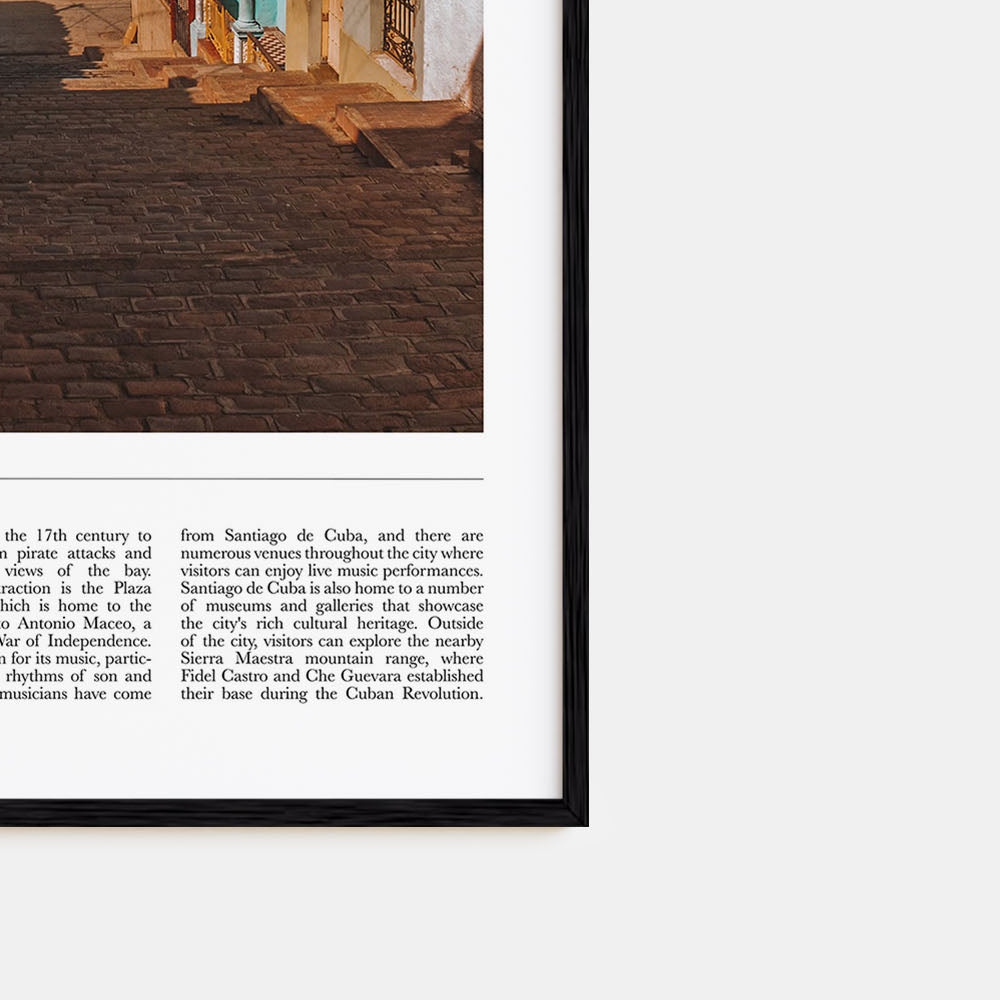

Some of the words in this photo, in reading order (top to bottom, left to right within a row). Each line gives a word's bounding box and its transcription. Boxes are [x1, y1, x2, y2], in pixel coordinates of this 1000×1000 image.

[180, 528, 215, 542] from
[224, 528, 288, 546] Santiago
[296, 528, 314, 542] de
[323, 528, 368, 544] Cuba,
[377, 529, 405, 542] and
[415, 529, 452, 542] there
[461, 533, 484, 542] are
[16, 547, 59, 563] pirate
[67, 546, 116, 559] attacks
[124, 546, 152, 559] and
[180, 550, 252, 559] numerous
[253, 550, 302, 559] venues
[304, 546, 384, 563] throughout
[386, 546, 410, 559] the
[412, 547, 439, 563] city
[440, 546, 484, 559] where
[4, 564, 44, 577] views
[56, 563, 74, 577] of
[87, 564, 111, 577] the
[124, 564, 152, 580] bay.
[180, 564, 231, 577] visitors
[234, 568, 260, 577] can
[264, 564, 304, 581] enjoy
[308, 564, 333, 577] live
[337, 564, 379, 577] music
[382, 563, 484, 581] performances.
[60, 582, 72, 594] is
[81, 581, 104, 594] the
[113, 581, 152, 594] Plaza
[39, 599, 50, 612] is
[58, 599, 99, 612] home
[106, 602, 121, 612] to
[129, 599, 152, 612] the
[180, 598, 198, 612] of
[205, 603, 272, 612] museums
[279, 599, 308, 612] and
[315, 599, 374, 615] galleries
[382, 599, 411, 612] that
[418, 599, 484, 612] showcase
[17, 617, 76, 629] Antonio
[83, 616, 136, 632] Maceo,
[143, 621, 152, 629] a
[180, 616, 204, 629] the
[212, 617, 248, 633] city's
[256, 616, 284, 629] rich
[292, 616, 348, 629] cultural
[357, 616, 418, 633] heritage.
[427, 616, 484, 629] Outside
[180, 651, 224, 664] Sierra
[235, 651, 294, 664] Maestra
[304, 652, 374, 664] mountain
[385, 656, 430, 668] range,
[440, 651, 484, 664] where
[5, 669, 64, 686] rhythms
[70, 669, 87, 682] of
[93, 673, 118, 682] son
[124, 669, 152, 682] and
[180, 669, 216, 682] Fidel
[221, 669, 269, 682] Castro
[273, 669, 301, 682] and
[305, 669, 336, 682] Che
[340, 669, 402, 682] Guevara
[406, 669, 484, 682] established
[73, 687, 107, 700] have
[113, 691, 152, 700] come
[180, 687, 215, 699] their
[221, 687, 253, 700] base
[260, 687, 309, 704] during
[315, 687, 338, 699] the
[345, 686, 395, 700] Cuban
[402, 686, 484, 700] Revolution.
